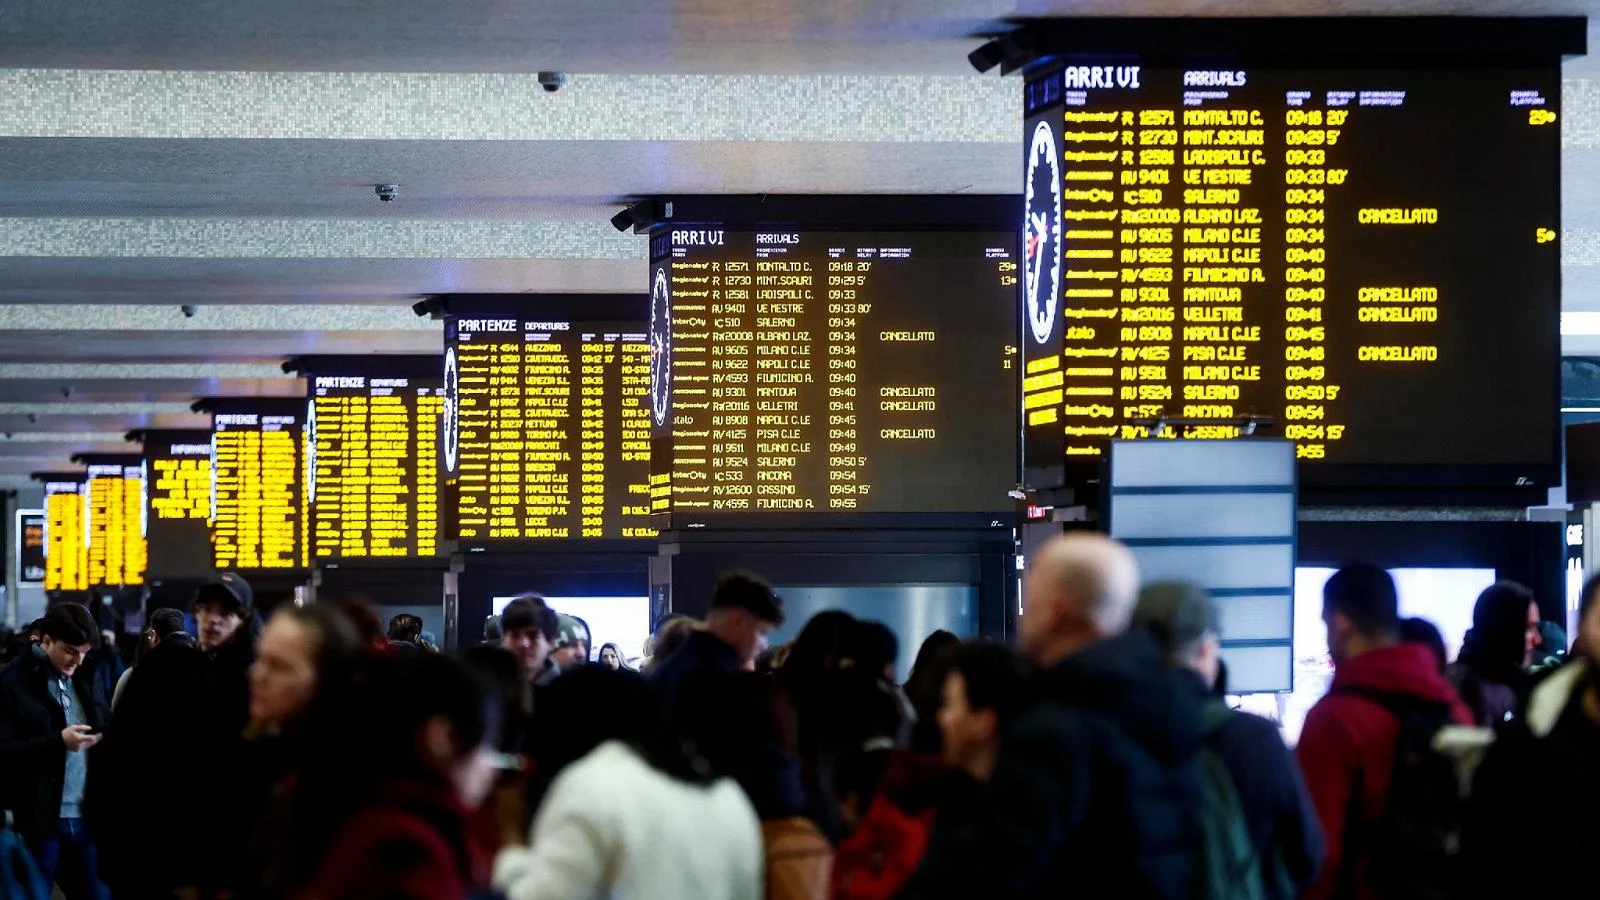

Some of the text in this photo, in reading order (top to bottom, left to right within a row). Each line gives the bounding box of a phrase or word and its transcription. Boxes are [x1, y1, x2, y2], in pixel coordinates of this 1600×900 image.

[1066, 67, 1139, 88] ARRIVI
[1184, 71, 1246, 86] ARRIVALS
[1184, 110, 1248, 125] MONTALTO
[1250, 110, 1263, 125] C.
[1184, 130, 1264, 145] MINT.SCAURI
[1184, 150, 1249, 165] LADISPOLI
[1252, 150, 1265, 164] C.
[1184, 169, 1201, 184] VE
[1203, 169, 1251, 184] MESTRE
[1184, 189, 1239, 203] SALERNO
[1184, 209, 1232, 223] ALBANO
[1234, 209, 1262, 223] LAZ.
[1359, 209, 1437, 223] CANCELLATO
[672, 231, 723, 244] ARRIVI
[757, 234, 799, 243] ARRIVALS
[725, 262, 749, 271] 12571
[757, 262, 801, 271] MONTALTO
[804, 262, 812, 271] C.
[829, 262, 853, 271] 09:18
[999, 262, 1010, 271] 29
[725, 276, 751, 285] 12730
[757, 276, 812, 285] MINT.SCAURI
[829, 276, 855, 285] 09:29
[1001, 276, 1010, 285] 13
[725, 290, 749, 299] 12581
[757, 290, 802, 299] LADISPOLI
[805, 290, 813, 299] C.
[829, 290, 855, 299] 09:33
[1184, 287, 1437, 302] MANTOVA CANCELLATO
[712, 304, 723, 313] AV
[725, 304, 745, 313] 9401
[757, 304, 768, 313] VE
[771, 304, 804, 313] MESTRE
[829, 304, 855, 313] 09:33
[1184, 307, 1437, 321] VELLETRI CANCELLATO
[459, 320, 516, 331] PARTENZE
[525, 322, 569, 330] DEPARTURES
[715, 319, 724, 328] IC
[725, 318, 740, 327] 510
[757, 318, 795, 327] SALERNO
[829, 318, 855, 327] 09:34
[757, 332, 790, 341] ALBANO
[793, 332, 811, 341] LAZ.
[829, 332, 855, 341] 09:34
[880, 332, 934, 341] CANCELLATO
[712, 346, 723, 356] AV
[725, 345, 748, 354] 9605
[757, 346, 788, 354] MILANO
[791, 346, 810, 354] C.LE
[829, 346, 855, 354] 09:34
[1005, 346, 1010, 354] 5
[1184, 346, 1437, 360] PISA C.LE CANCELLATO
[712, 360, 723, 369] AV
[725, 360, 748, 369] 9622
[757, 360, 788, 368] NAPOLI
[791, 360, 810, 369] C.LE
[829, 360, 856, 368] 09:40
[1004, 360, 1011, 368] 11
[726, 374, 748, 383] 4593
[757, 374, 803, 382] FIUMICINO
[805, 373, 813, 382] A.
[829, 373, 856, 382] 09:40
[712, 388, 723, 398] AV
[726, 387, 746, 396] 9301
[757, 388, 796, 396] MANTOVA
[829, 387, 856, 396] 09:40
[880, 387, 935, 396] CANCELLATO
[1184, 385, 1239, 399] SALERNO
[757, 401, 798, 410] VELLETRI
[830, 402, 854, 410] 09:41
[881, 401, 935, 410] CANCELLATO
[713, 416, 723, 425] AV
[726, 415, 748, 425] 8908
[757, 415, 788, 424] NAPOLI
[791, 416, 810, 424] C.LE
[830, 415, 856, 424] 09:45
[726, 429, 746, 439] 4125
[757, 429, 779, 439] PISA
[781, 429, 800, 438] C.LE
[830, 429, 856, 438] 09:48
[881, 429, 935, 438] CANCELLATO
[713, 444, 723, 453] AV
[726, 443, 744, 452] 9511
[757, 443, 788, 452] MILANO
[791, 443, 810, 452] C.LE
[830, 443, 856, 452] 09:49
[713, 458, 723, 467] AV
[726, 457, 748, 467] 9524
[757, 457, 795, 467] SALERNO
[830, 457, 856, 466] 09:50
[715, 472, 724, 481] IC
[726, 471, 743, 480] 533
[757, 471, 791, 481] ANCONA
[830, 471, 856, 480] 09:54
[726, 485, 752, 494] 12600
[757, 484, 795, 494] CASSINO
[830, 485, 856, 494] 09:54
[725, 499, 748, 508] 4595
[757, 499, 803, 508] FIUMICINO
[805, 499, 814, 508] A.
[830, 499, 856, 508] 09:55
